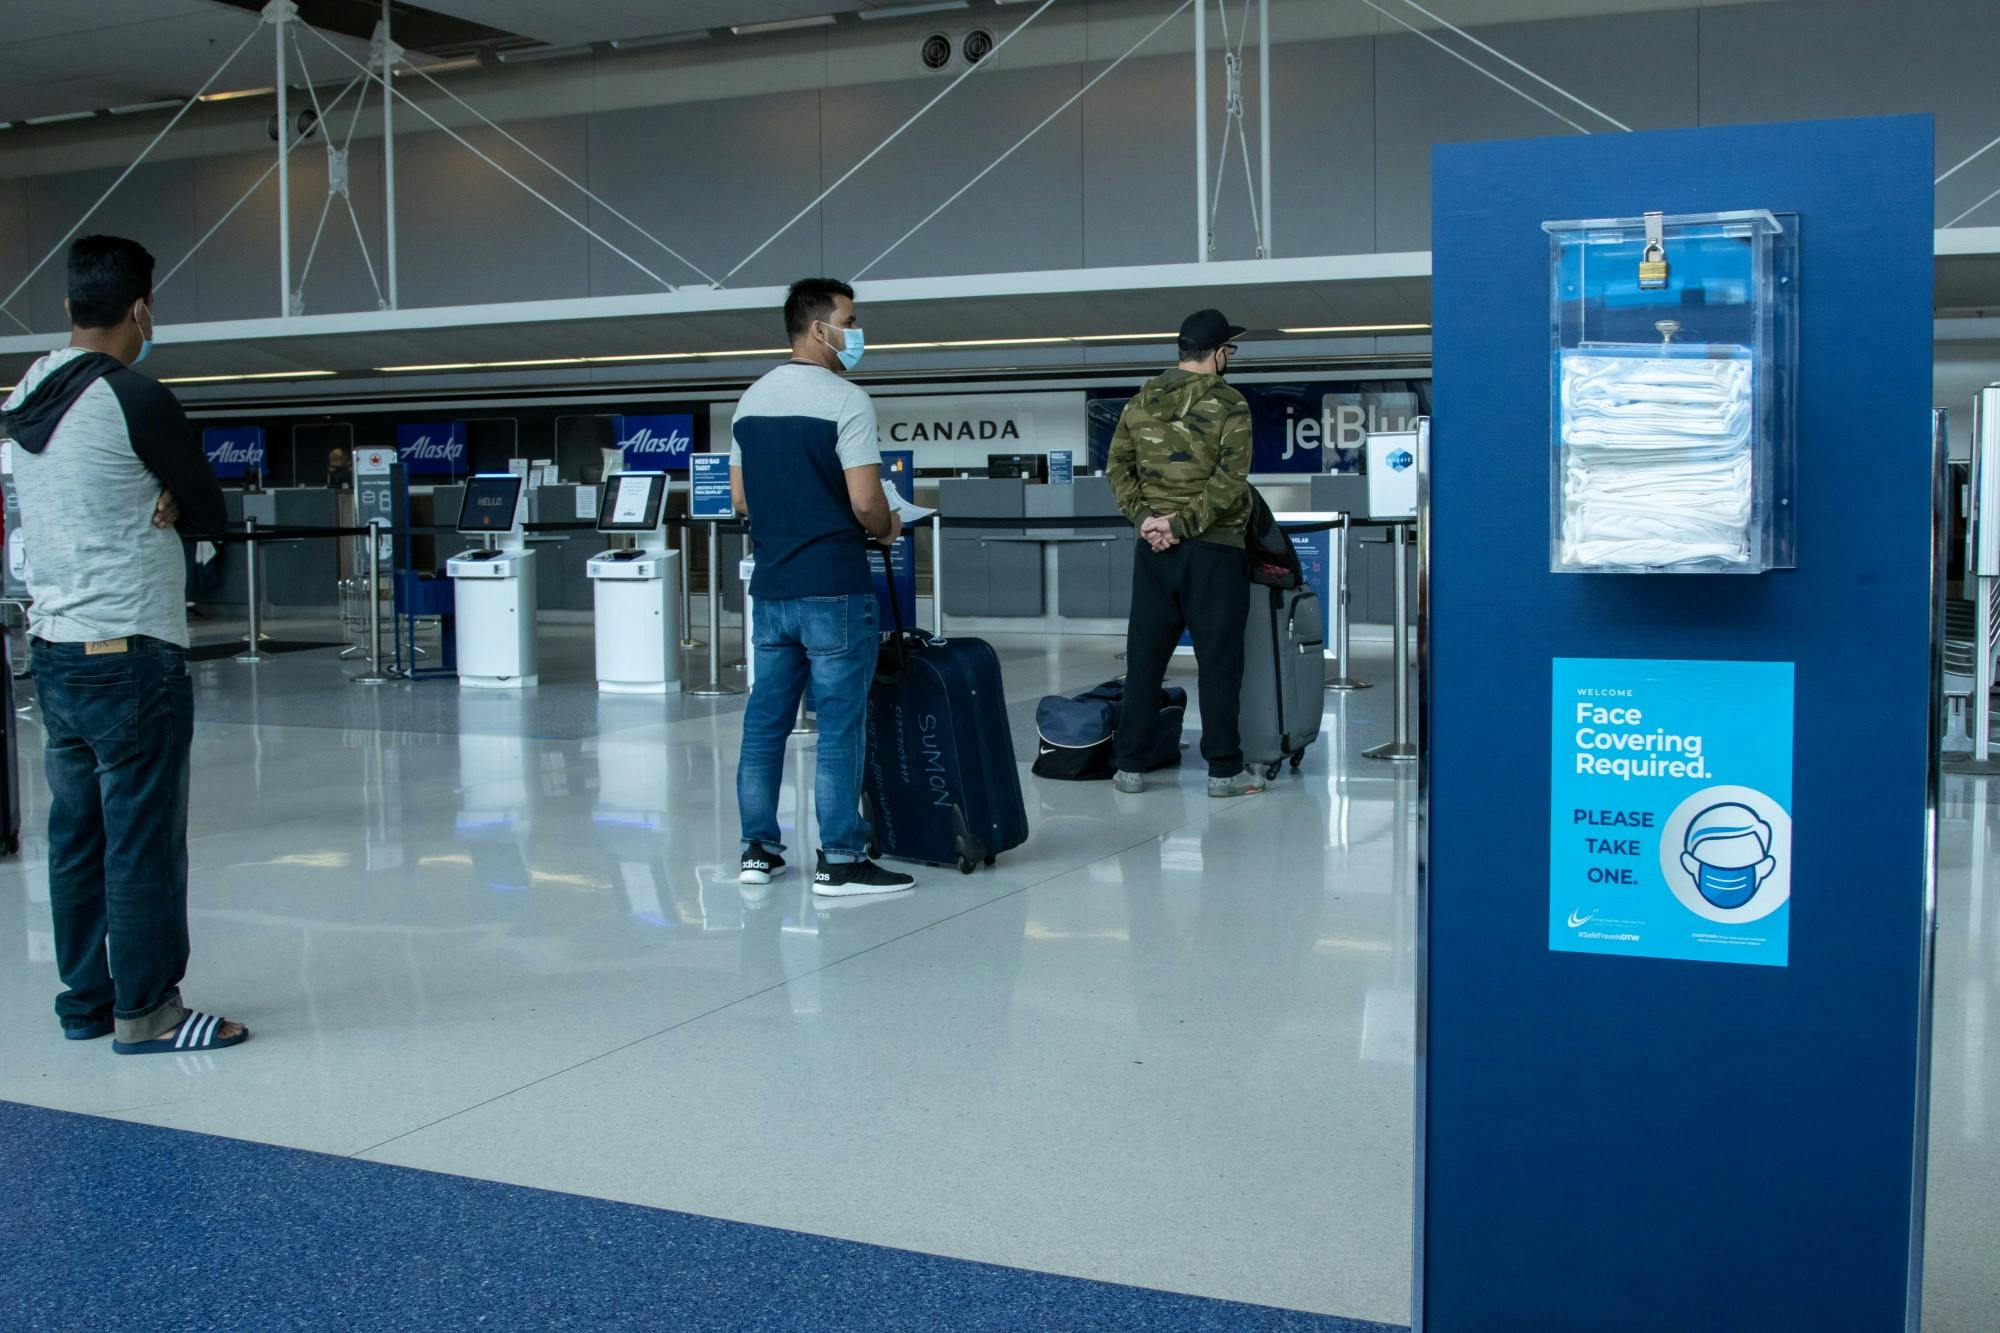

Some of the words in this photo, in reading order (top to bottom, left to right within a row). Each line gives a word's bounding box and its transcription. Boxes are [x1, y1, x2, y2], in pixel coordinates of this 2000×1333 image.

[617, 428, 690, 456] Alaska
[890, 420, 1020, 442] CANADA
[206, 440, 264, 466] Alaska
[400, 434, 464, 462] Alaska
[1577, 688, 1633, 697] WELCOME
[1576, 702, 1642, 725] Face
[1575, 727, 1702, 758] Covering
[918, 713, 953, 807] SUMON
[1576, 752, 1712, 781] Required.
[1574, 809, 1654, 828] PLEASE
[1585, 838, 1641, 856] TAKE
[1587, 867, 1638, 885] ONE.
